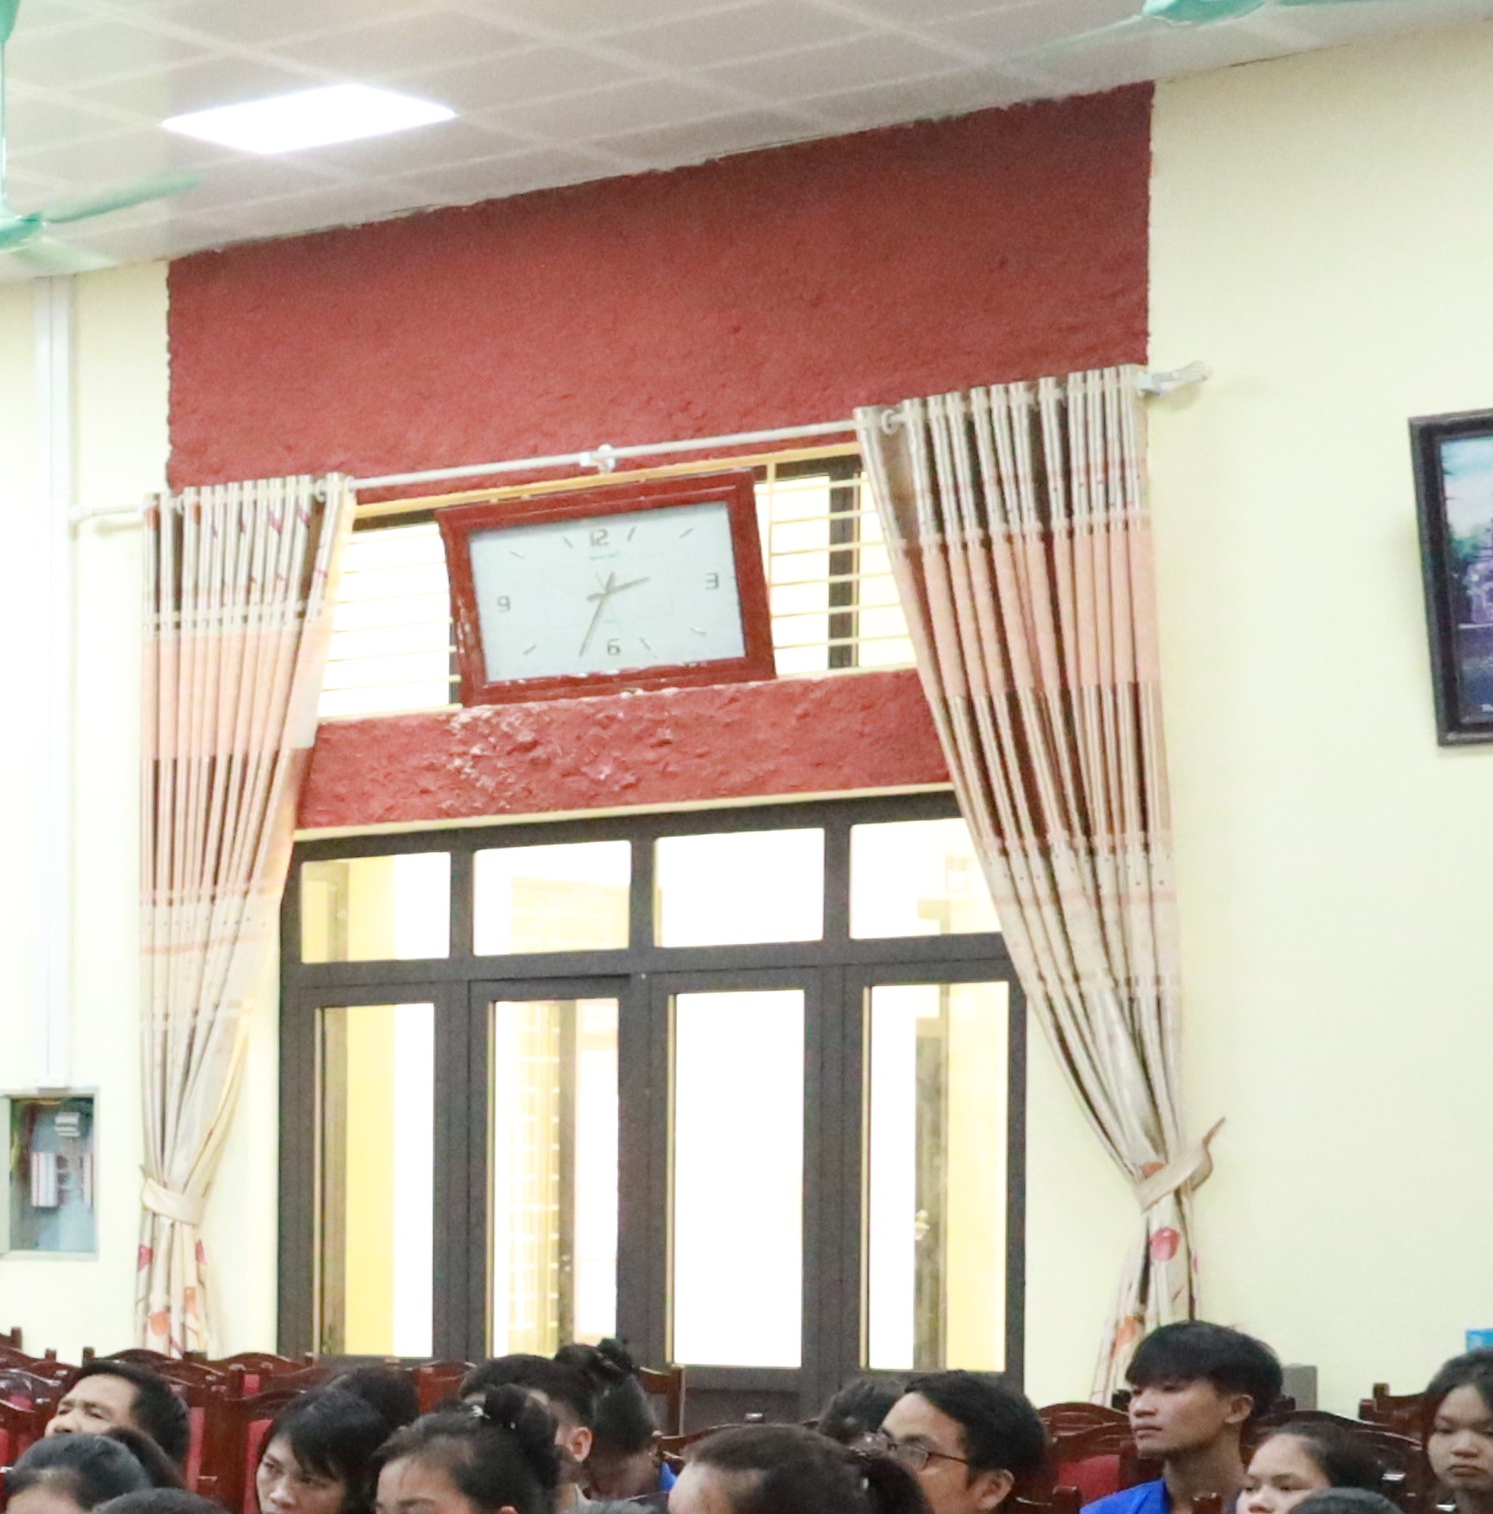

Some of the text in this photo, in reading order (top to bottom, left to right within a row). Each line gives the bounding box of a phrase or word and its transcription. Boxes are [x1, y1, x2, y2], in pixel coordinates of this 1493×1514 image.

[590, 527, 610, 547] 12
[705, 572, 720, 591] 3
[607, 638, 621, 656] 6
